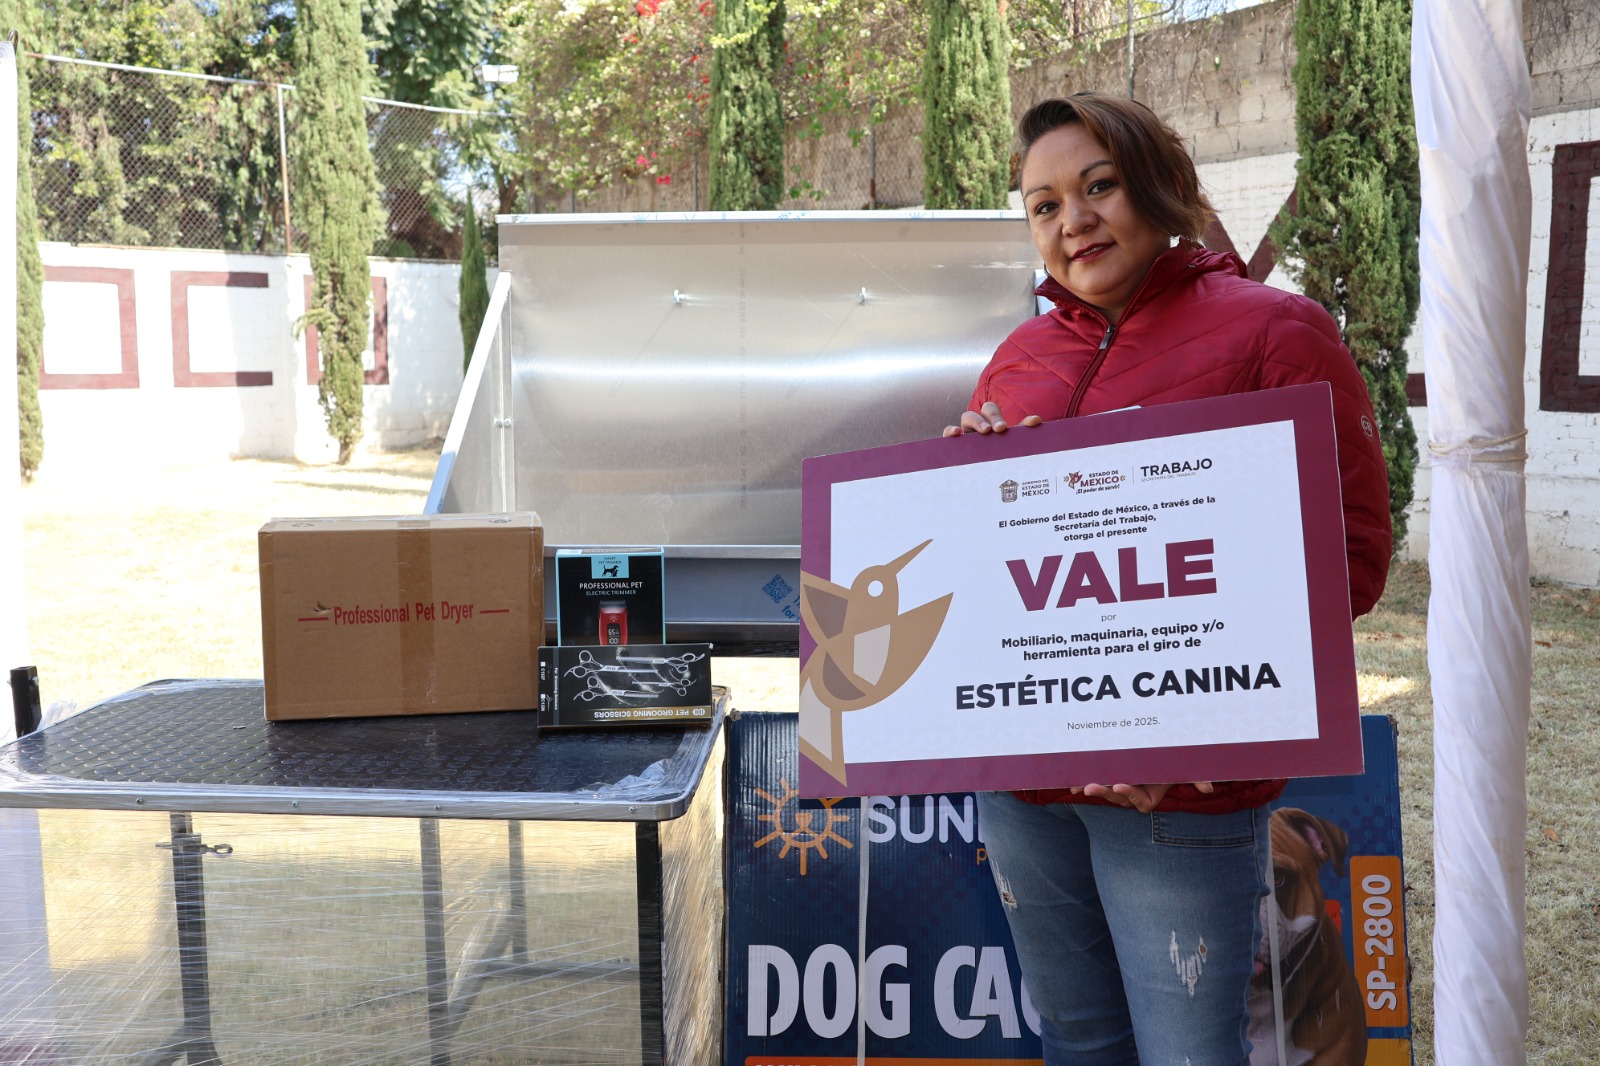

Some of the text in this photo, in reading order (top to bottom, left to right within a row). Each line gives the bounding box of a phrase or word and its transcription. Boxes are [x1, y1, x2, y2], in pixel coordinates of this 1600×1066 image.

[1140, 458, 1212, 477] TRABAJO
[998, 520, 1008, 529] El
[1010, 515, 1050, 528] Gobierno
[1052, 513, 1066, 522] del
[1068, 510, 1100, 520] Estado
[1102, 507, 1114, 518] de
[1116, 504, 1151, 516] México,
[1160, 498, 1190, 510] través
[1192, 496, 1204, 506] de
[1206, 496, 1216, 504] la
[1054, 514, 1157, 532] Secretaría del Trabajo,
[1064, 526, 1148, 542] otorga el presente
[580, 582, 630, 590] PROFESSIONAL
[1005, 538, 1218, 612] VALE
[333, 600, 474, 626] Professional Pet Dryer
[782, 605, 795, 618] for
[1101, 613, 1116, 623] por
[1001, 619, 1225, 649] Mobiliario, maquinaria, equipo y/o
[1023, 636, 1202, 661] herramienta para el giro de
[956, 662, 1282, 710] ESTÉTICA CANINA
[594, 710, 632, 718] SCISSORS
[633, 709, 674, 717] GROOMING
[1067, 716, 1160, 730] Noviembre de 2025.
[867, 795, 985, 844] SUN
[1361, 874, 1398, 1011] SP-2800
[747, 943, 911, 1039] DOG
